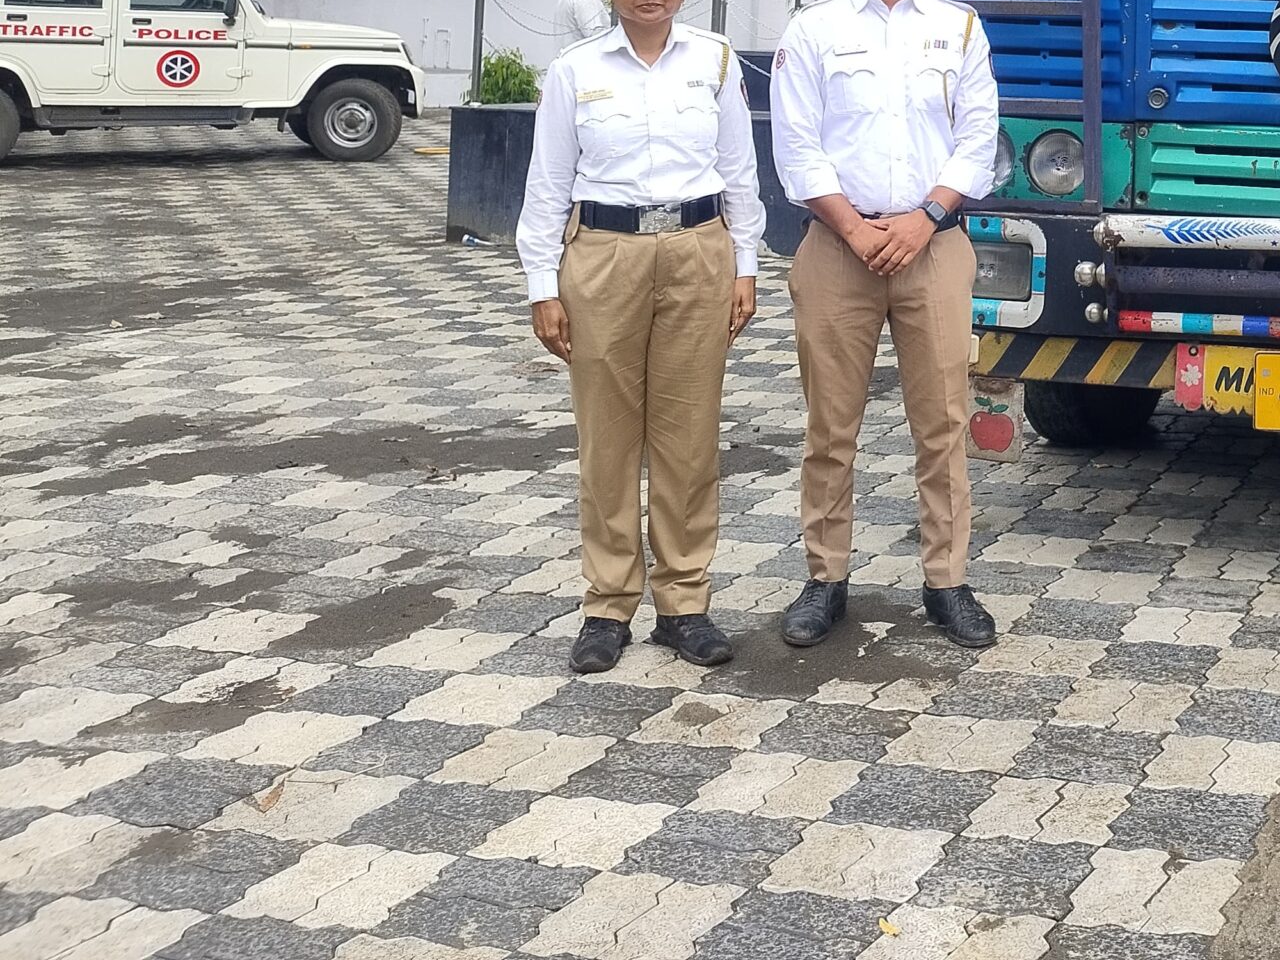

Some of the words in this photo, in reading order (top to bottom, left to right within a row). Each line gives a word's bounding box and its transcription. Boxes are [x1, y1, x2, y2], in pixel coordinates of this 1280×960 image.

[1, 24, 94, 38] TRAFFIC
[136, 27, 228, 41] POLICE
[1258, 387, 1275, 396] IND
